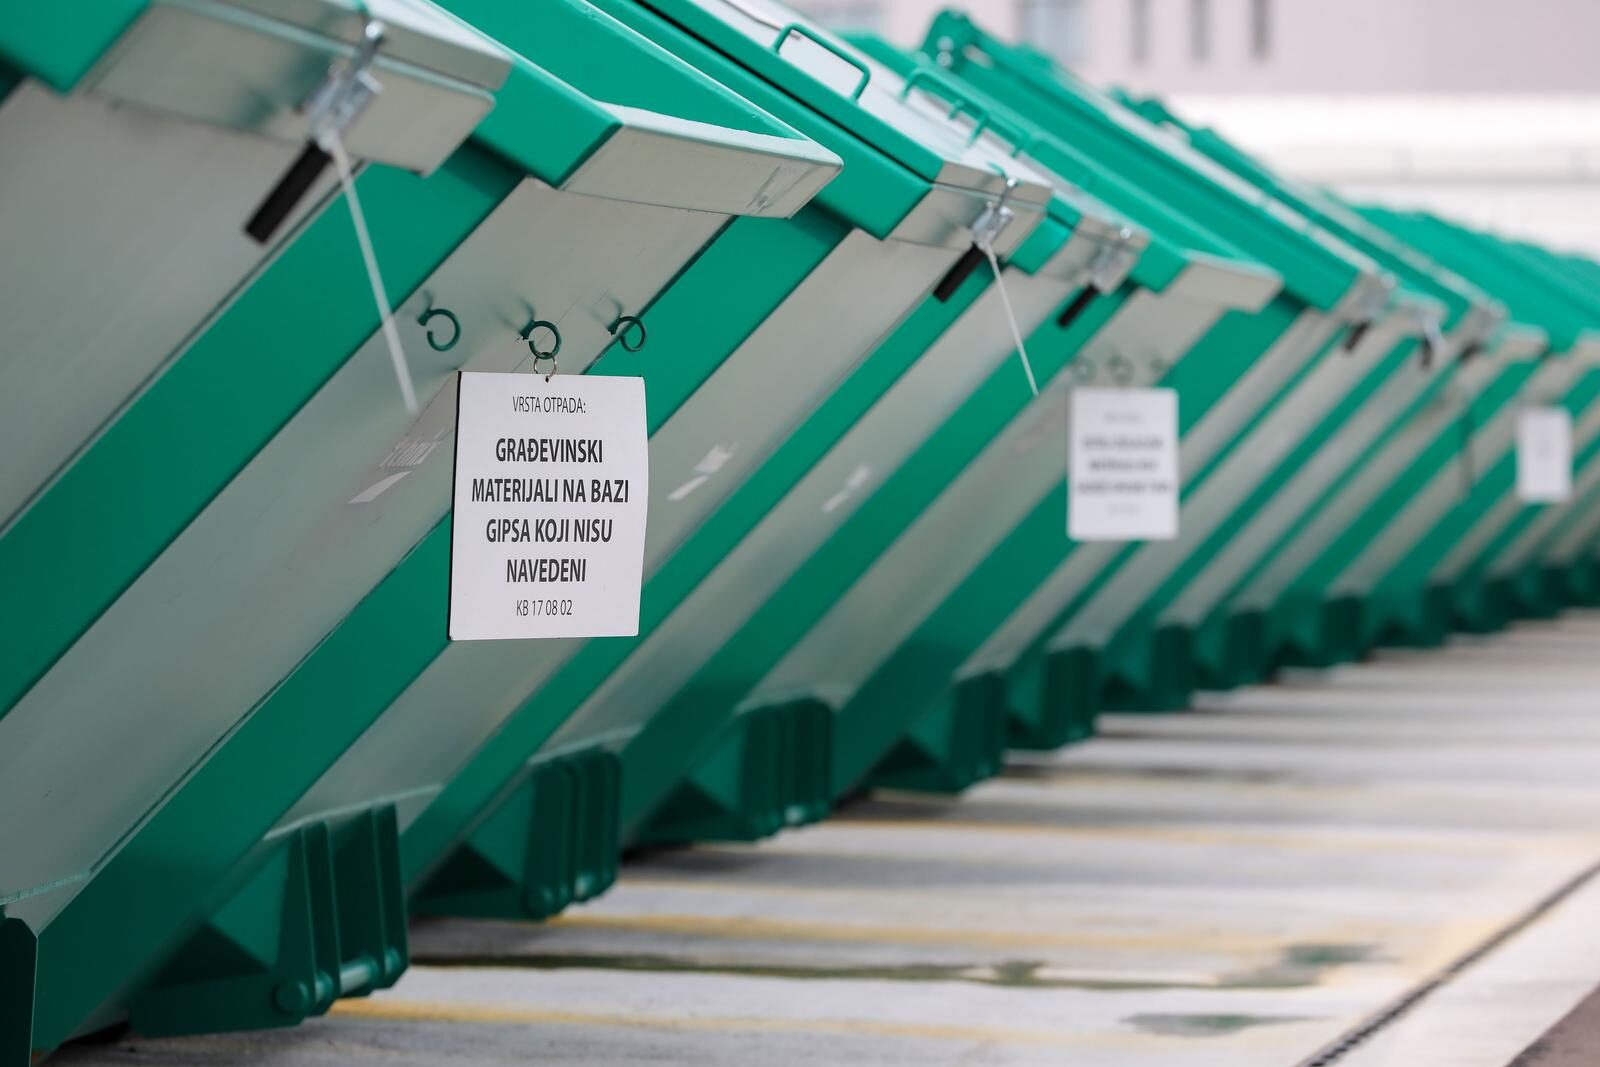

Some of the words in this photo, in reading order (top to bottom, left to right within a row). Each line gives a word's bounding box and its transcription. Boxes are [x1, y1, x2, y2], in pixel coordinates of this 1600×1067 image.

[513, 396, 541, 413] VRSTA
[543, 397, 587, 414] OTPADA:
[496, 438, 603, 463] GRAĐEVINSKI
[472, 478, 558, 503] MATERIJALI
[563, 479, 587, 503] NA
[591, 479, 629, 503] BAZI
[486, 519, 530, 543] GIPSA
[535, 519, 569, 543] KOJI
[574, 519, 613, 543] NISU
[507, 559, 587, 583] NAVEDENI
[516, 600, 529, 616] KB
[532, 600, 543, 616] 17
[546, 600, 558, 616] 08
[560, 600, 573, 616] 02
